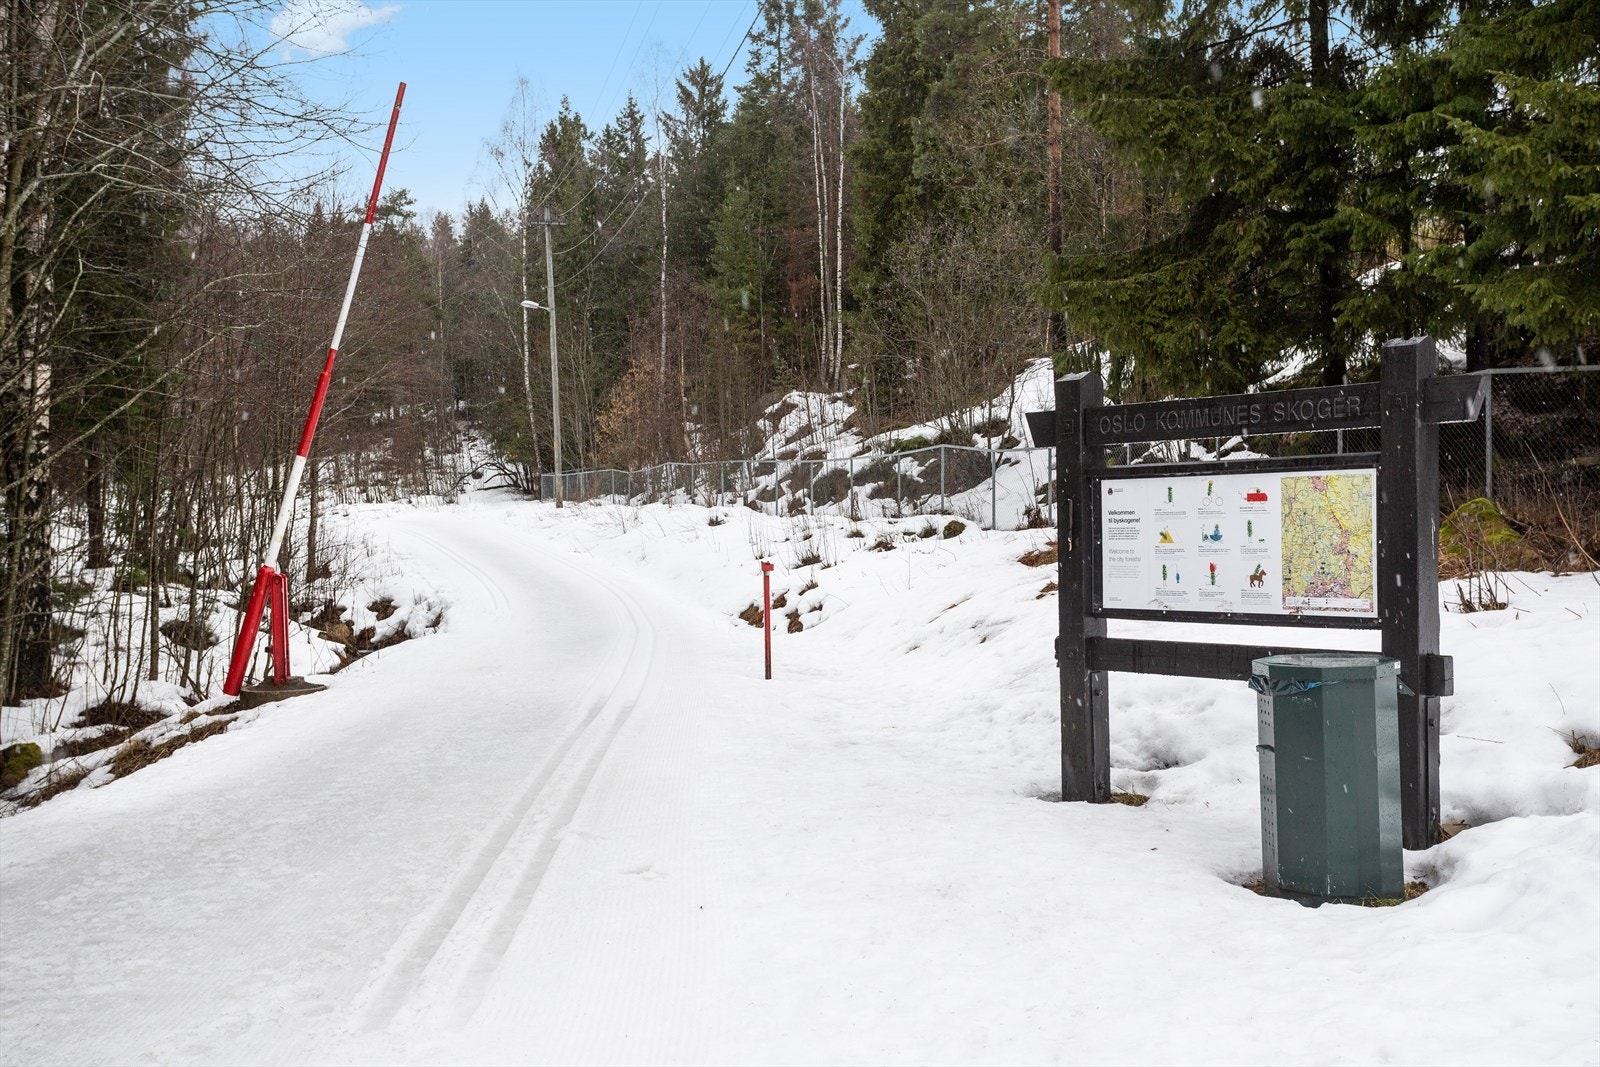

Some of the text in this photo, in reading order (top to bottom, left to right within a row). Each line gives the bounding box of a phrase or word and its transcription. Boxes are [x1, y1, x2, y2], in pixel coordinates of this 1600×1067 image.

[1099, 396, 1361, 435] OSLO KOMMUNES SKOGER
